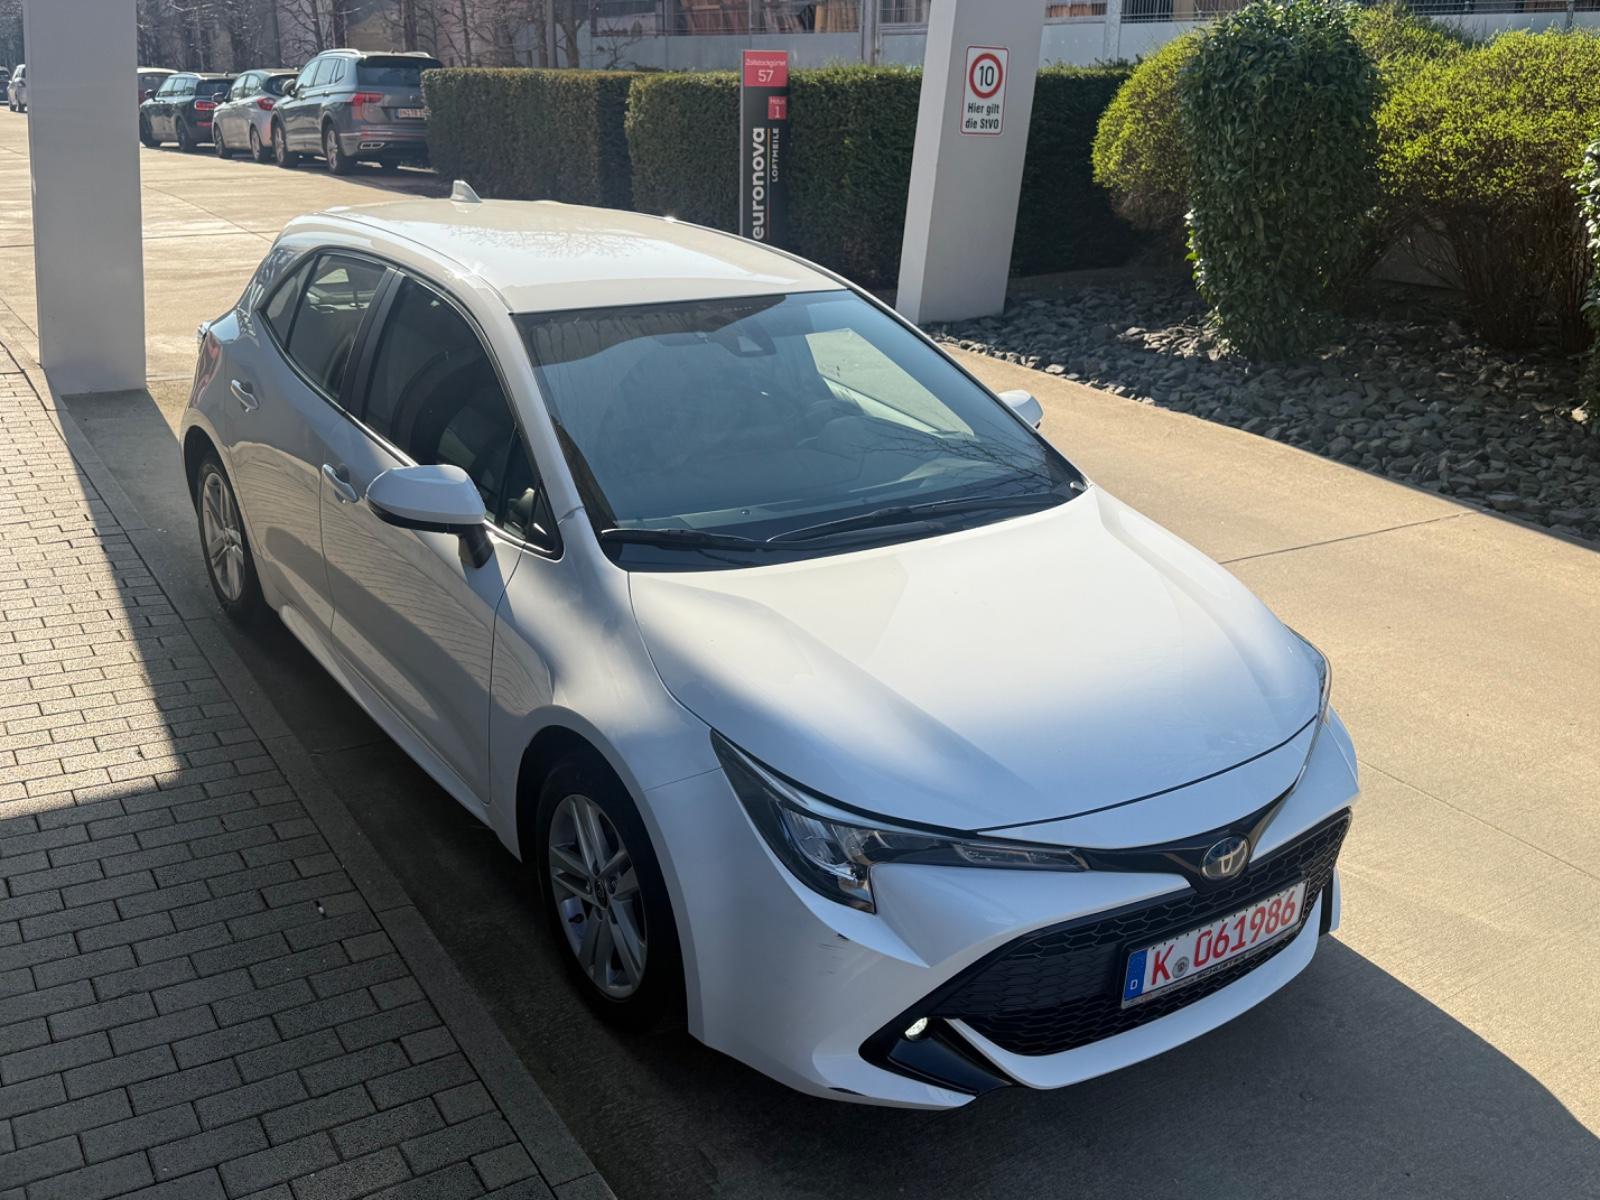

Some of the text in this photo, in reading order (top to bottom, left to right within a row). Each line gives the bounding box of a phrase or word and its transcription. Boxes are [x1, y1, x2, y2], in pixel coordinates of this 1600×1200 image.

[758, 69, 774, 83] 57
[979, 65, 995, 87] 10
[774, 105, 781, 119] 1
[967, 102, 1000, 117] Hier gilt
[965, 118, 999, 130] die StVO
[771, 128, 780, 183] LOFTMEILE
[752, 128, 765, 240] euronova
[1151, 889, 1297, 986] K 061986
[1130, 979, 1138, 990] D
